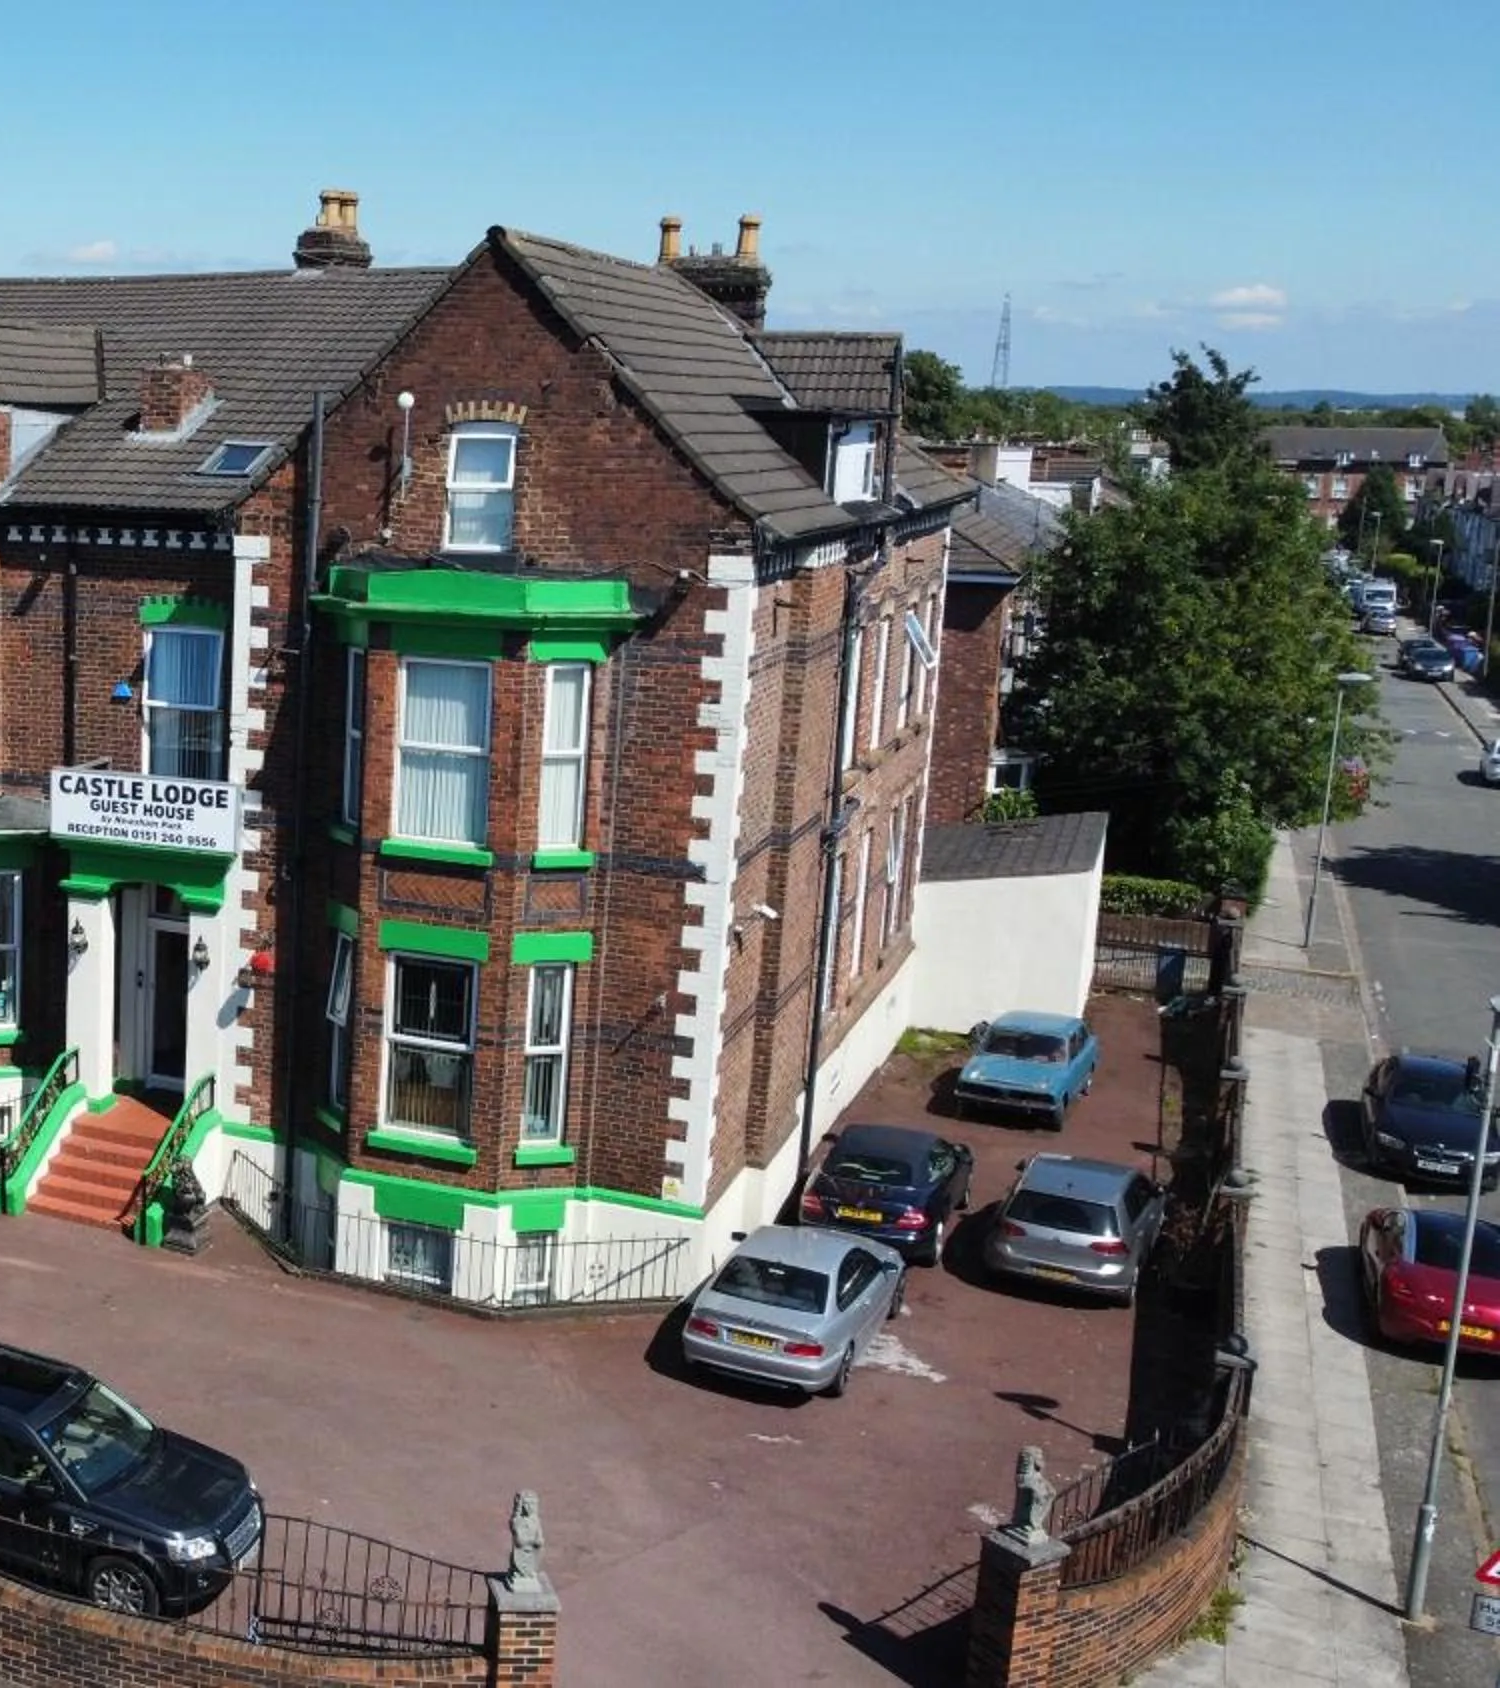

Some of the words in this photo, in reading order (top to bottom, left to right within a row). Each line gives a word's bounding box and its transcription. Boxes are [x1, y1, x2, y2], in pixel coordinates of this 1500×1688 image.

[59, 775, 144, 800] CASTLE
[151, 783, 229, 809] LODGE
[90, 799, 138, 815] GUEST
[143, 806, 195, 821] HOUSE
[67, 823, 129, 838] RECEPTION
[132, 830, 157, 841] 0151
